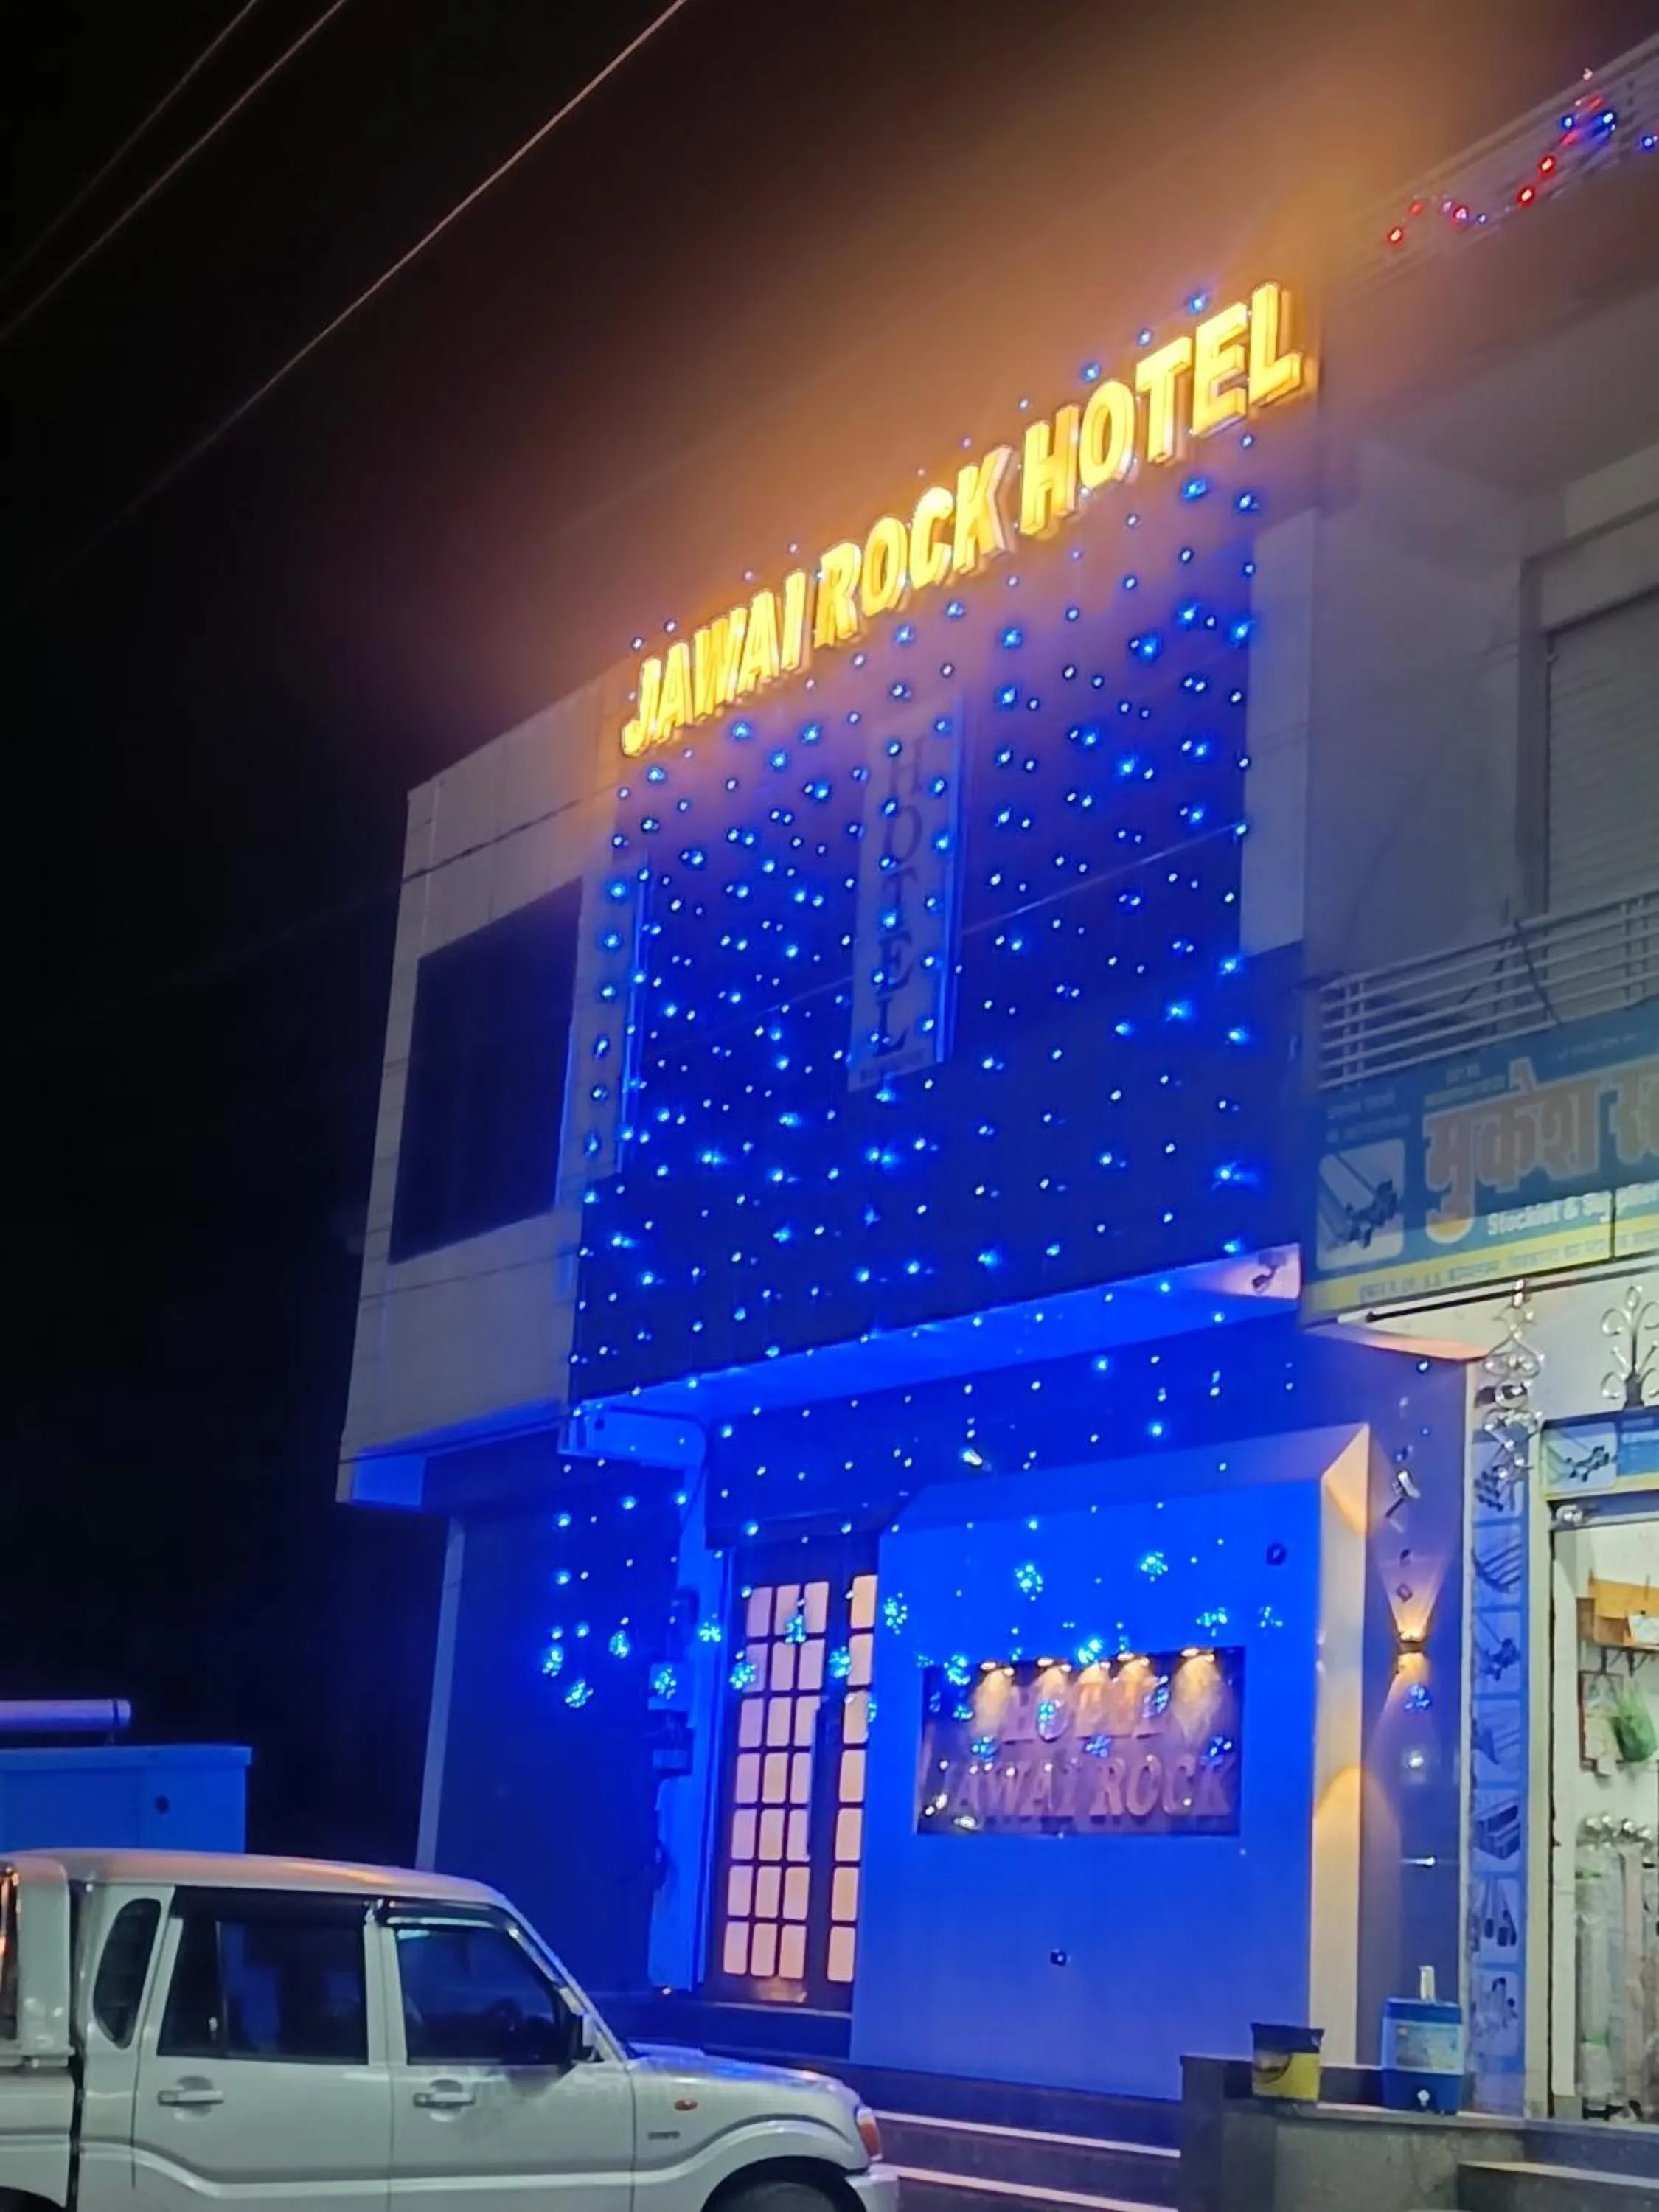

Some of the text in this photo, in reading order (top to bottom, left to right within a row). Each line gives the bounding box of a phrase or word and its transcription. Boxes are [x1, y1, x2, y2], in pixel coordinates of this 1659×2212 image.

[621, 282, 1317, 758] JAWAI ROCK HOTEL
[872, 735, 926, 1057] HOTEL
[1422, 1057, 1602, 1245] मुकेश
[1088, 1752, 1235, 1817] ROCK
